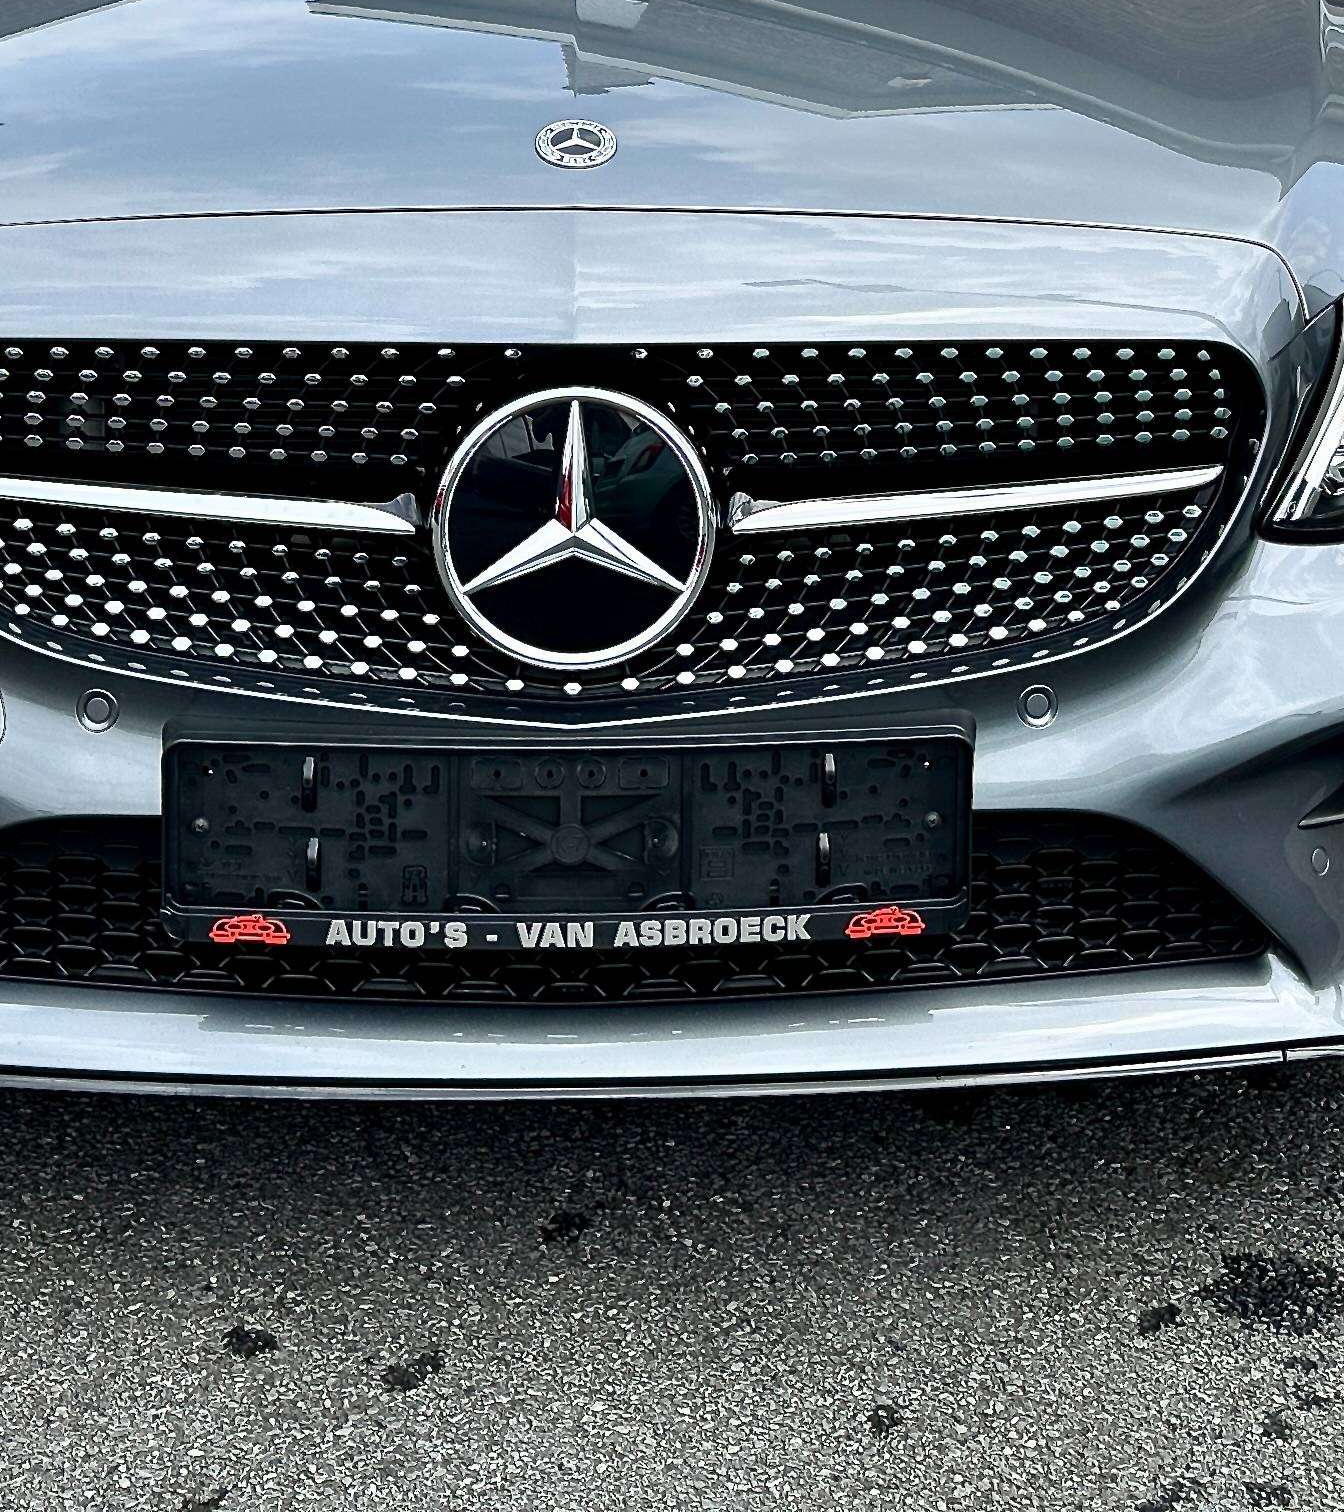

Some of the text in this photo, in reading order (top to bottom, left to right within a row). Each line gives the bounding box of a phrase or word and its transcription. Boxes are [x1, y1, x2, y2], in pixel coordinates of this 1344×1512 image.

[326, 919, 467, 948] AUTO'S
[517, 921, 594, 948] VAN
[613, 914, 812, 948] ASBROECK
